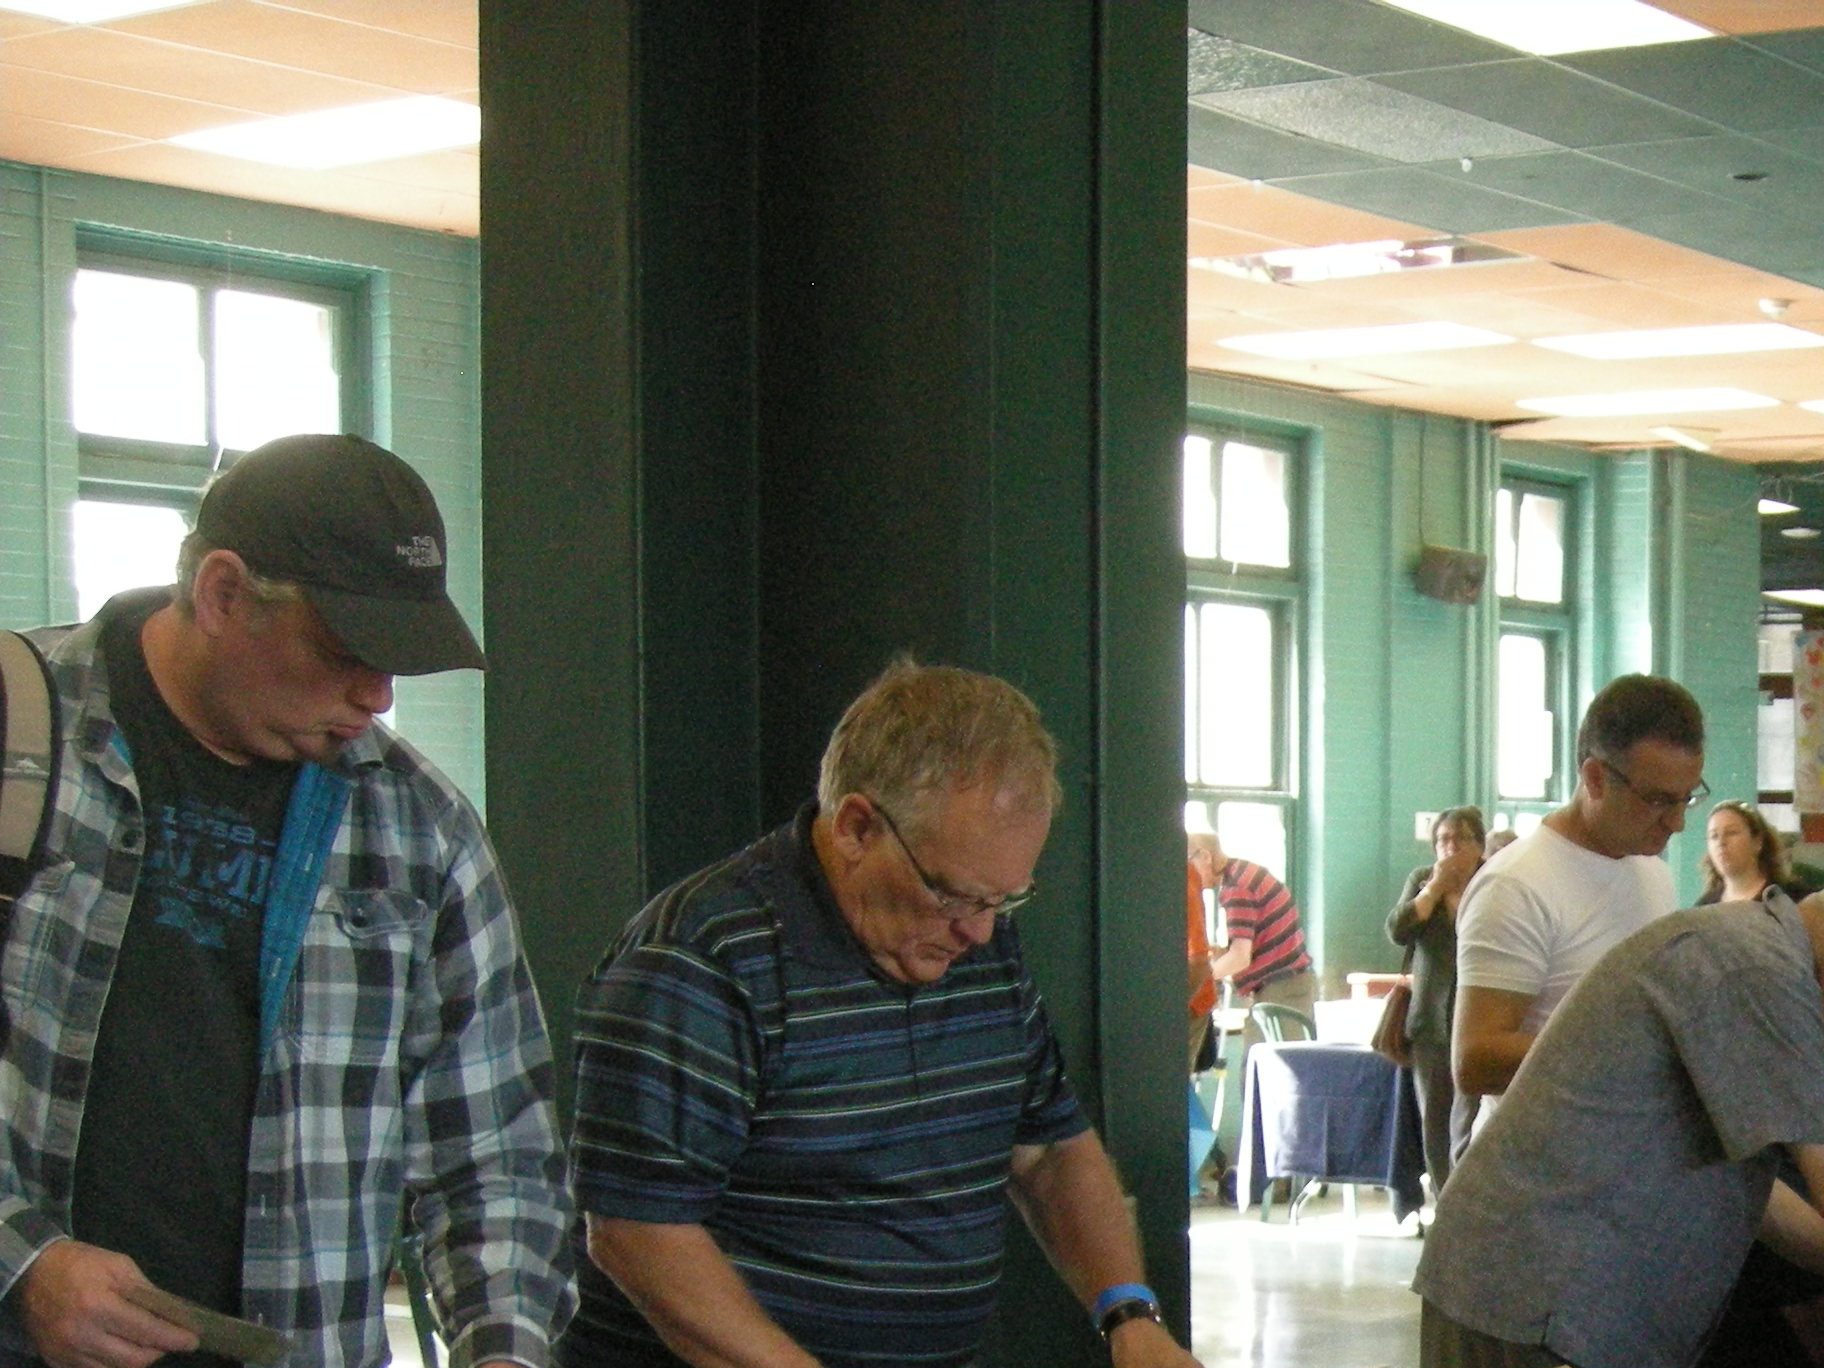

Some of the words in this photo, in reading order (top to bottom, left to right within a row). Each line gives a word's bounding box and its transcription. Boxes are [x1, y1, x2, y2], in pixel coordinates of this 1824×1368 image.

[412, 535, 431, 546] THE
[396, 545, 431, 557] NORTH
[408, 556, 433, 567] FACE
